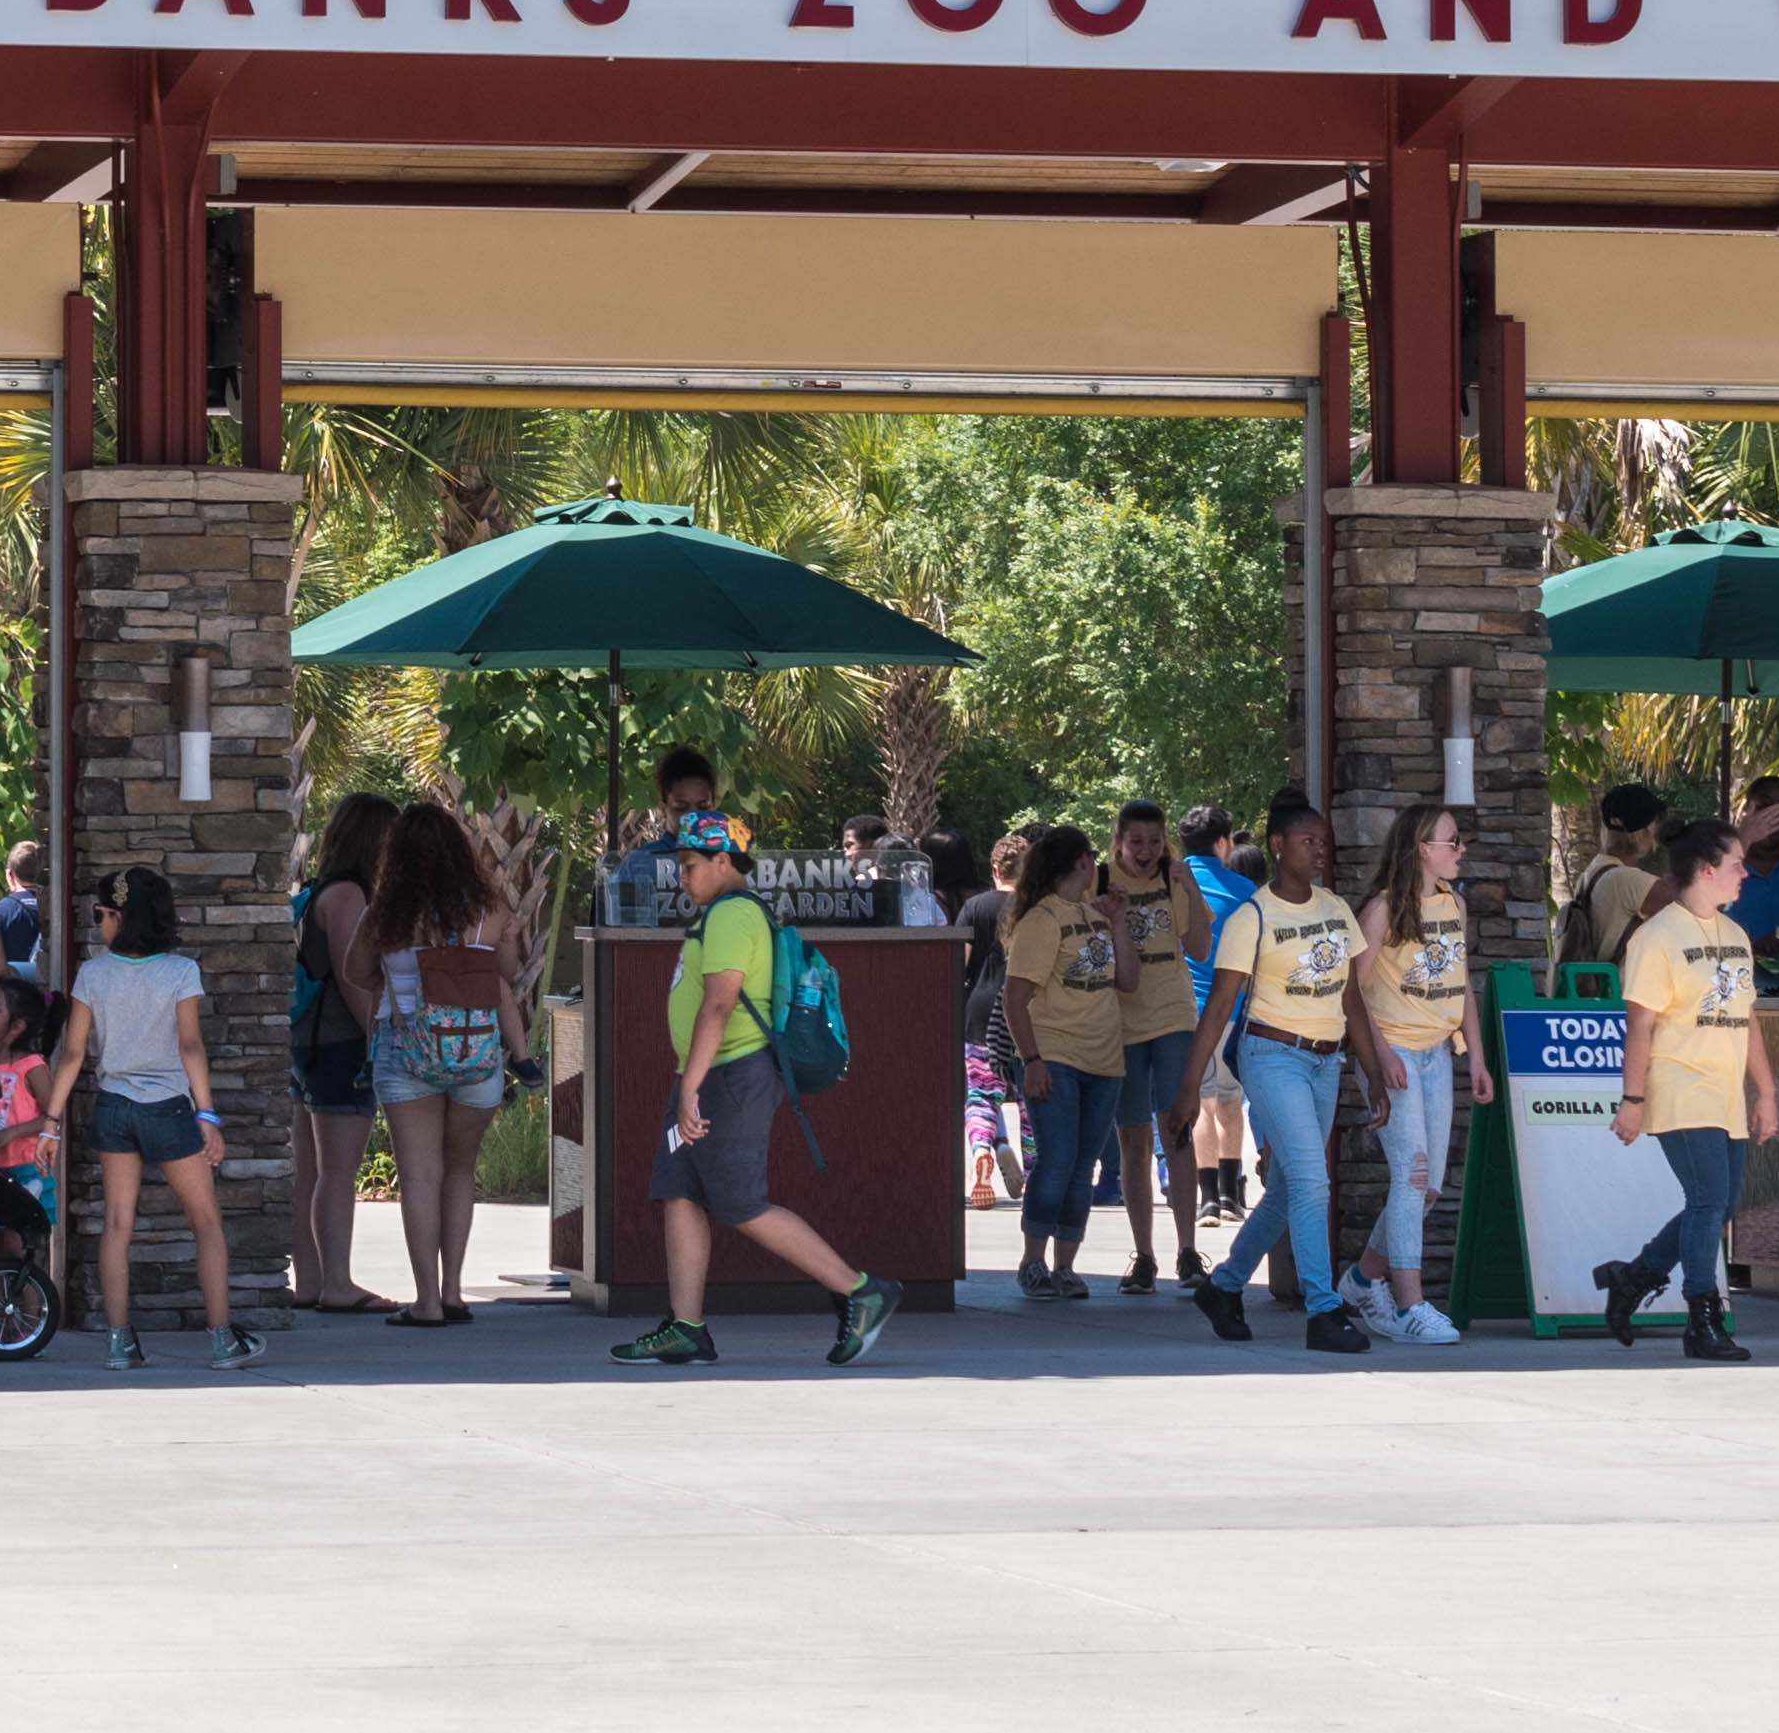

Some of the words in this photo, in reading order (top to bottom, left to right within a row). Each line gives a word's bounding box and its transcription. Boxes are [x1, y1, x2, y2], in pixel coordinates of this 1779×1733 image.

[656, 859, 873, 889] RBANKS
[659, 892, 707, 917] ZO
[1532, 1101, 1604, 1115] GORILLA
